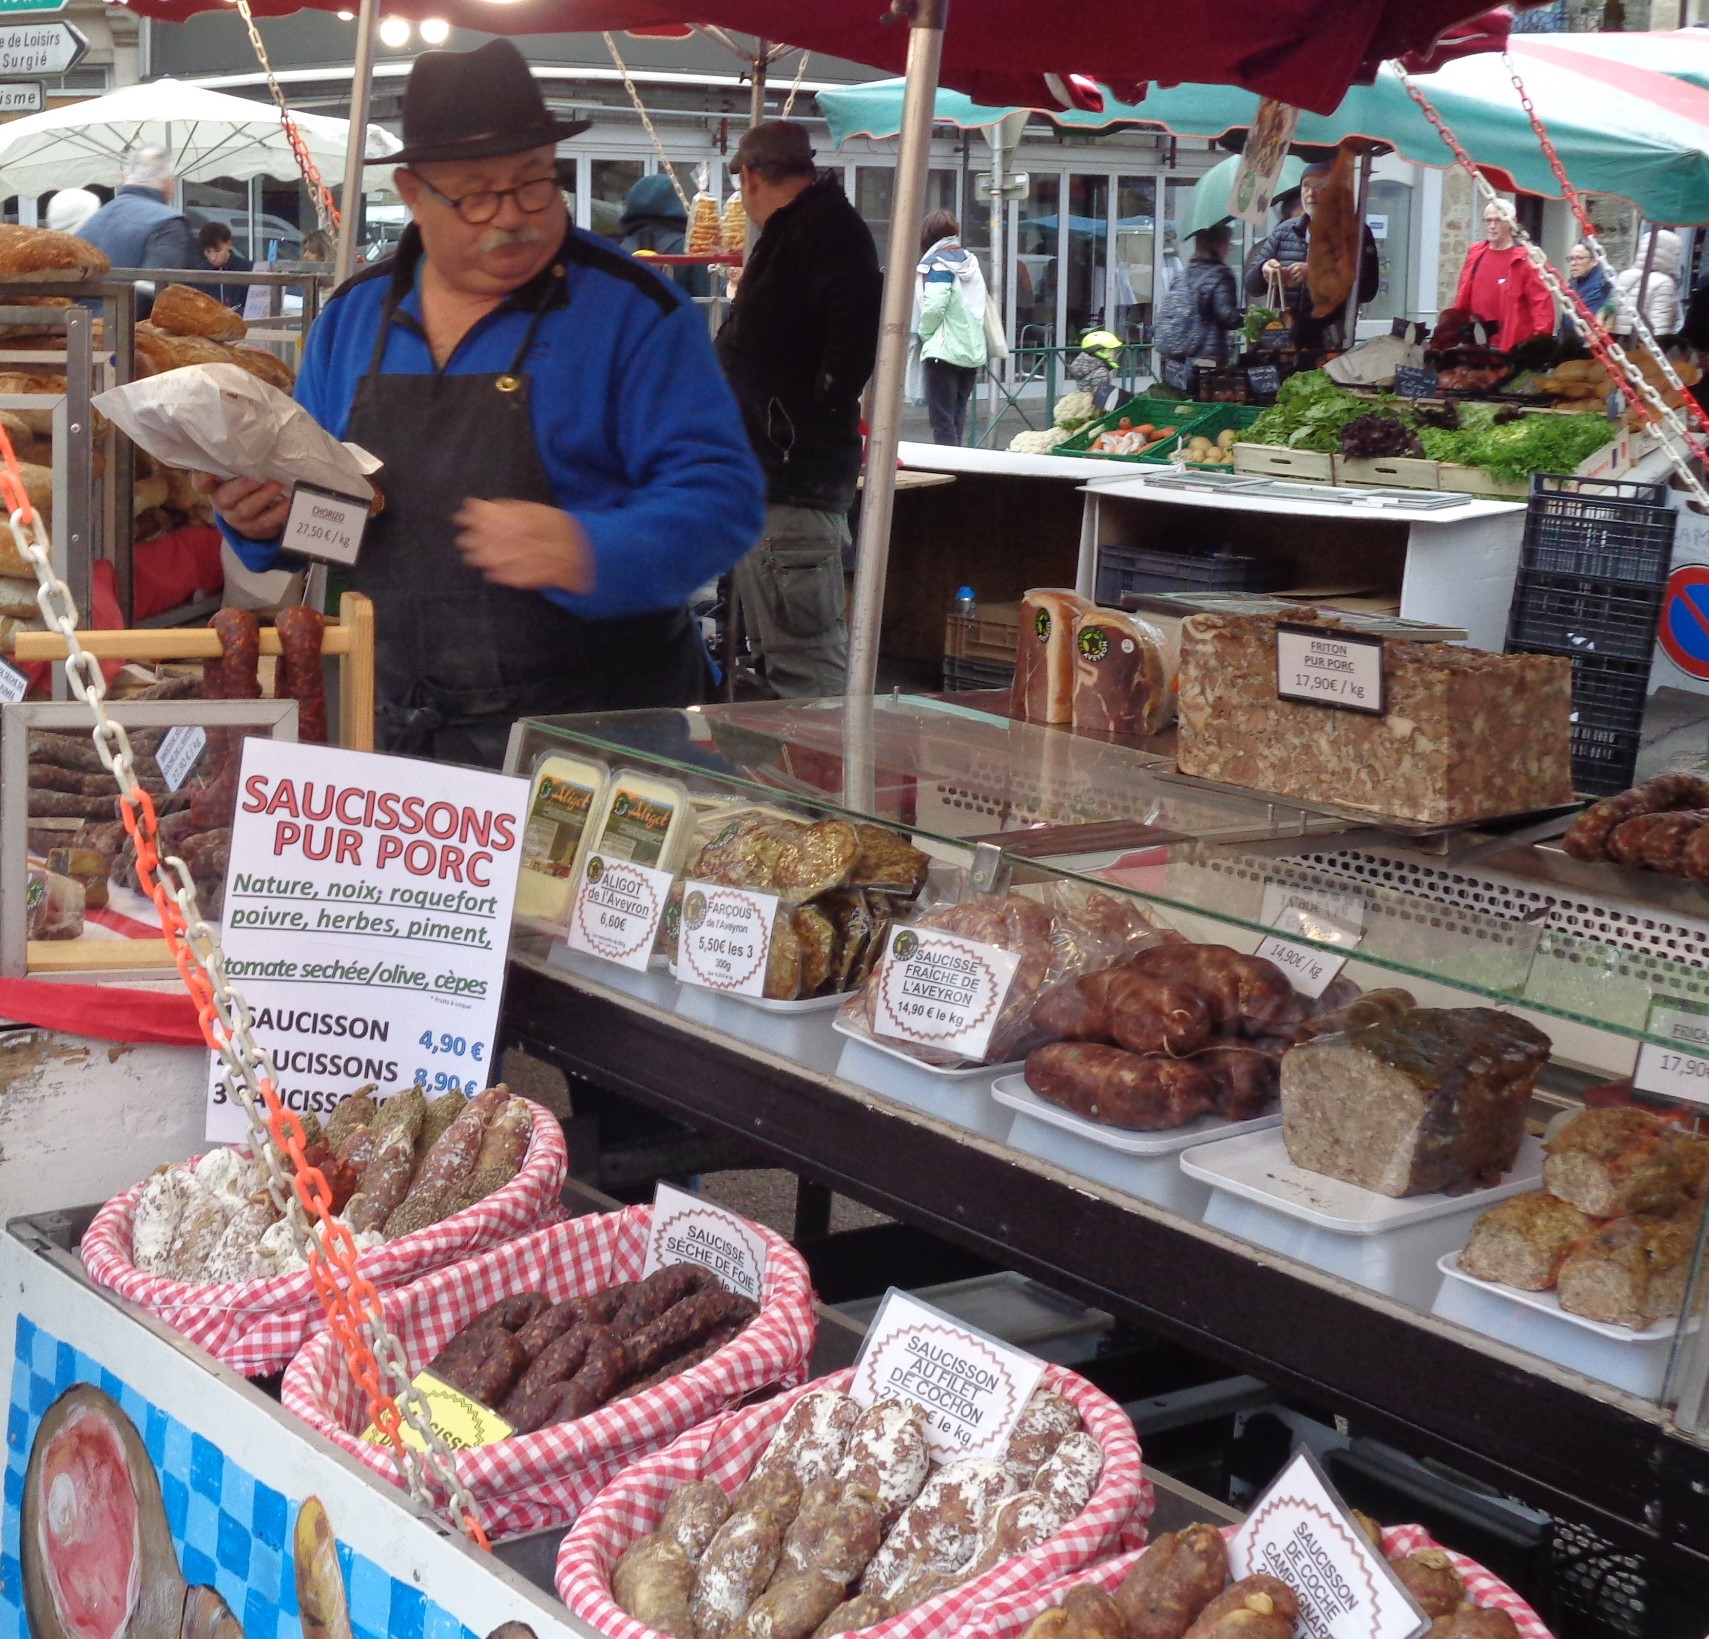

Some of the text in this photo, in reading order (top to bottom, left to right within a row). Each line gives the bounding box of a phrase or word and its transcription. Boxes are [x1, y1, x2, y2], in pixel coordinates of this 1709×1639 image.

[8, 33, 21, 47] de
[24, 31, 60, 47] Loisirs
[3, 50, 47, 71] Surgié
[312, 506, 345, 522] CHORIZO
[296, 522, 323, 538] 27,50
[325, 530, 331, 541] €
[339, 533, 351, 549] kg
[1311, 641, 1348, 655] FRITON
[1304, 655, 1355, 671] PUR PORC
[1296, 674, 1338, 692] 17,90€
[1351, 682, 1365, 699] kg
[550, 785, 589, 812] Aligot
[242, 775, 516, 851] SAUCISSONS
[628, 801, 669, 829] Aligot
[273, 821, 363, 865] PUR
[376, 834, 494, 888] PORC
[232, 873, 319, 899] Nature,
[389, 886, 498, 914] roquefort
[602, 874, 643, 896] ALIGOT
[588, 887, 649, 916] de l'Aveyron
[707, 901, 752, 919] FARÇOUS
[230, 906, 492, 948] poivre, herbes, piment,
[600, 912, 627, 932] 6,60€
[706, 919, 748, 934] de l'Aveyron
[698, 936, 754, 959] 5,50€ les 3
[915, 949, 979, 973] SAUCISSE
[224, 956, 488, 995] tomate sechée/olive, cèpes
[715, 958, 731, 972] 300g
[1270, 944, 1306, 968] 14,90€
[1309, 963, 1323, 980] kg
[903, 980, 973, 1005] L'AVEYRON
[961, 976, 980, 990] DE
[898, 1001, 964, 1028] 14,90 € le kg
[418, 1030, 467, 1056] 4,90
[471, 1041, 485, 1061] €
[213, 1083, 228, 1104] 3
[413, 1068, 461, 1092] 8,90
[464, 1080, 478, 1099] €
[687, 1225, 745, 1262] SAUCISSE
[666, 1236, 713, 1265] SÈCHE
[715, 1256, 731, 1275] DE
[732, 1266, 755, 1291] FOIE
[907, 1335, 999, 1390] SAUCISSON
[910, 1358, 981, 1401] AU FILET
[890, 1367, 984, 1424] DE COCHON
[926, 1410, 937, 1425] €
[937, 1416, 951, 1432] le
[954, 1426, 972, 1446] kg
[1296, 1522, 1359, 1611] SAUCISSON
[1286, 1540, 1341, 1621] DE COCHE
